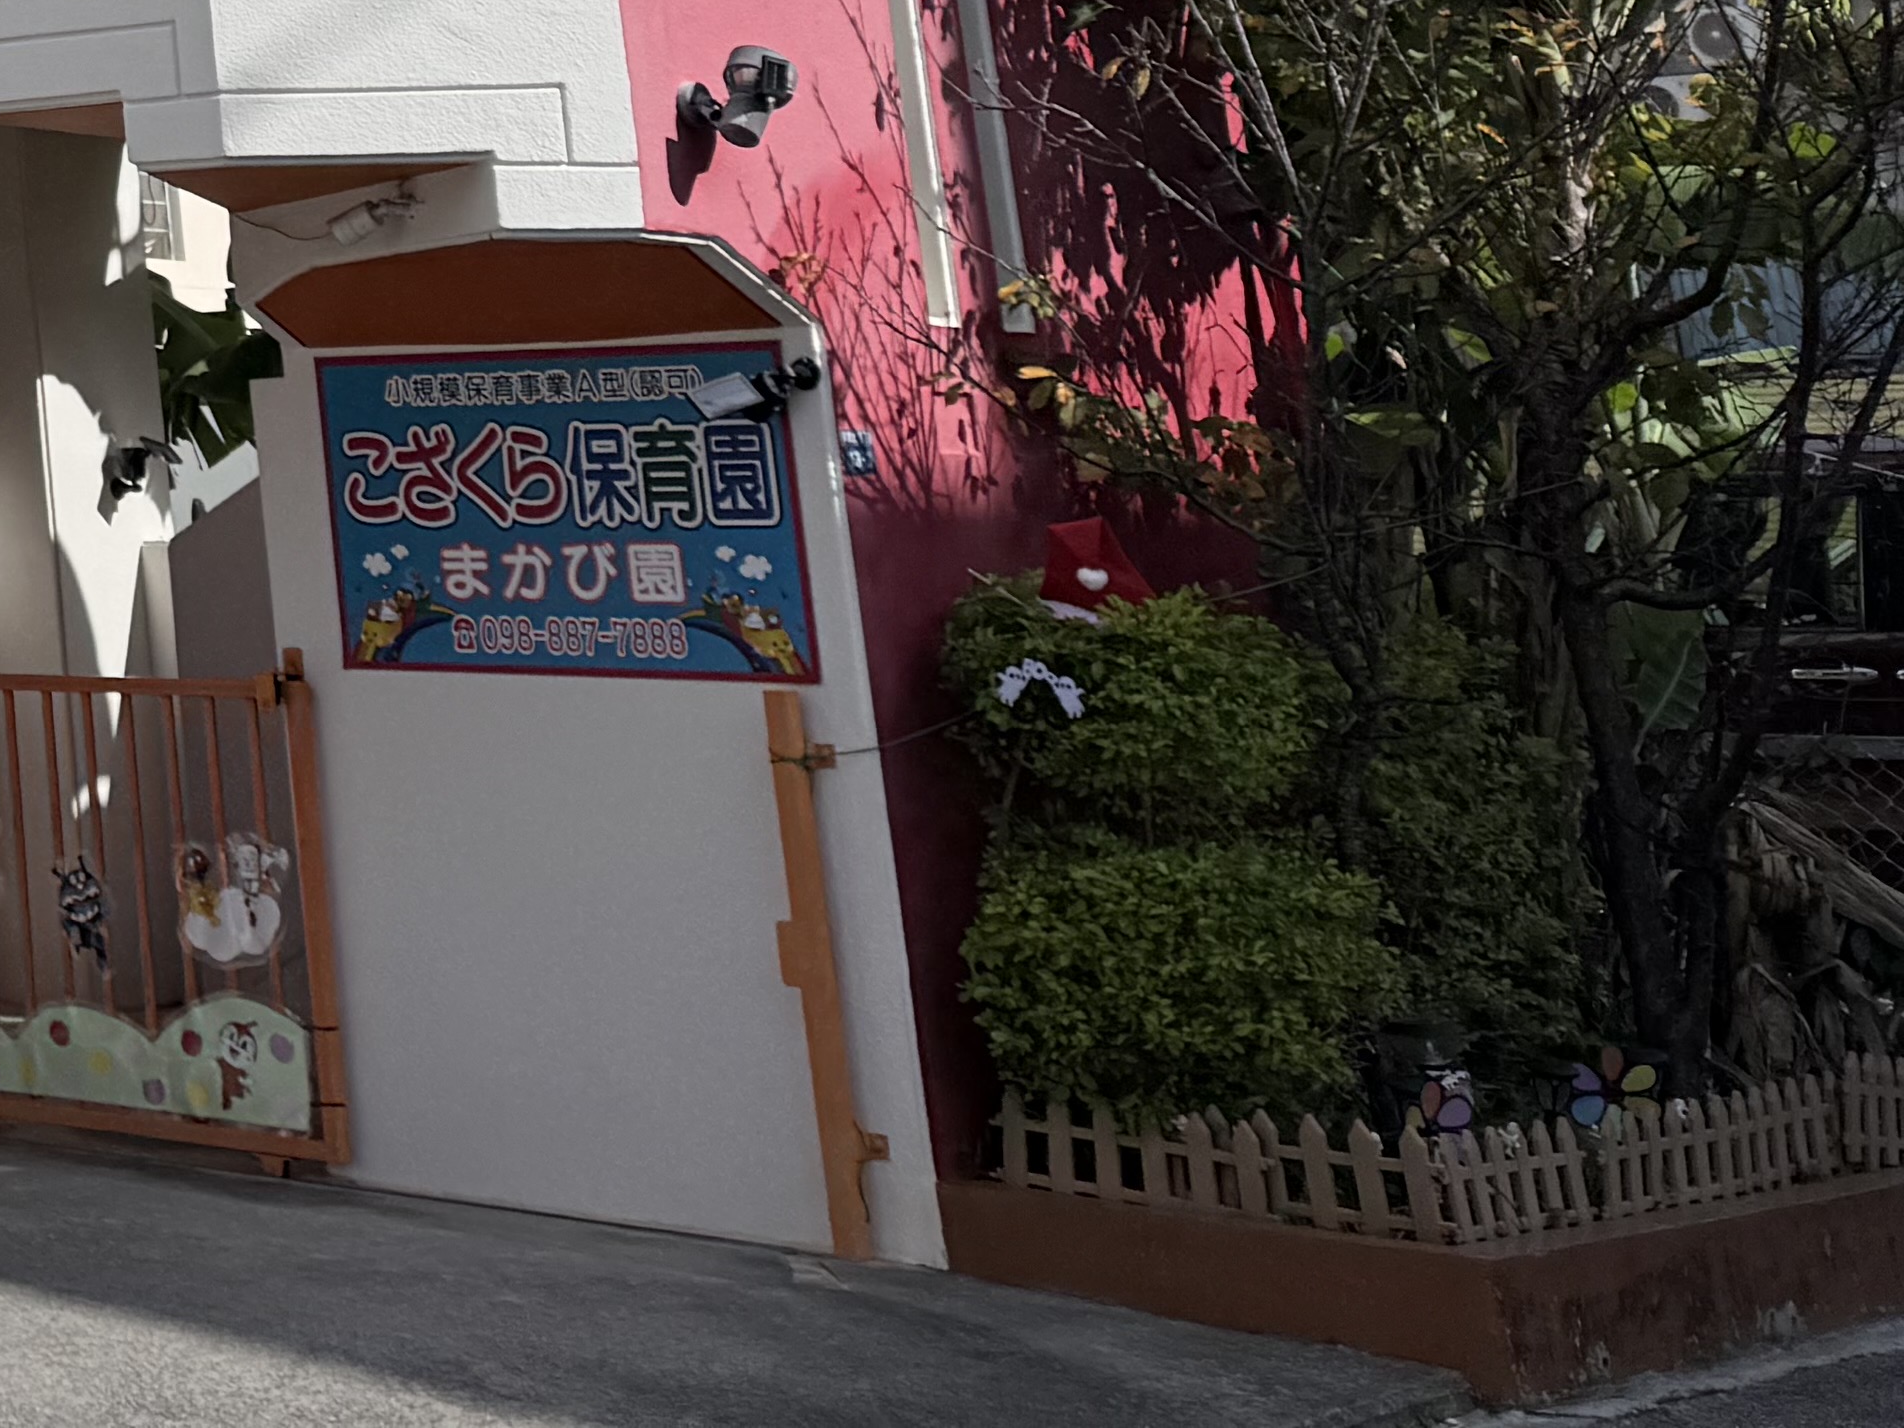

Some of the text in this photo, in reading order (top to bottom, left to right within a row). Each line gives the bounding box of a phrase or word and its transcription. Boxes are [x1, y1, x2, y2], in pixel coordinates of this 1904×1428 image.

[344, 419, 780, 528] こざくら保育園
[442, 543, 686, 603] まかび園
[482, 615, 687, 658] 098-887-7888
